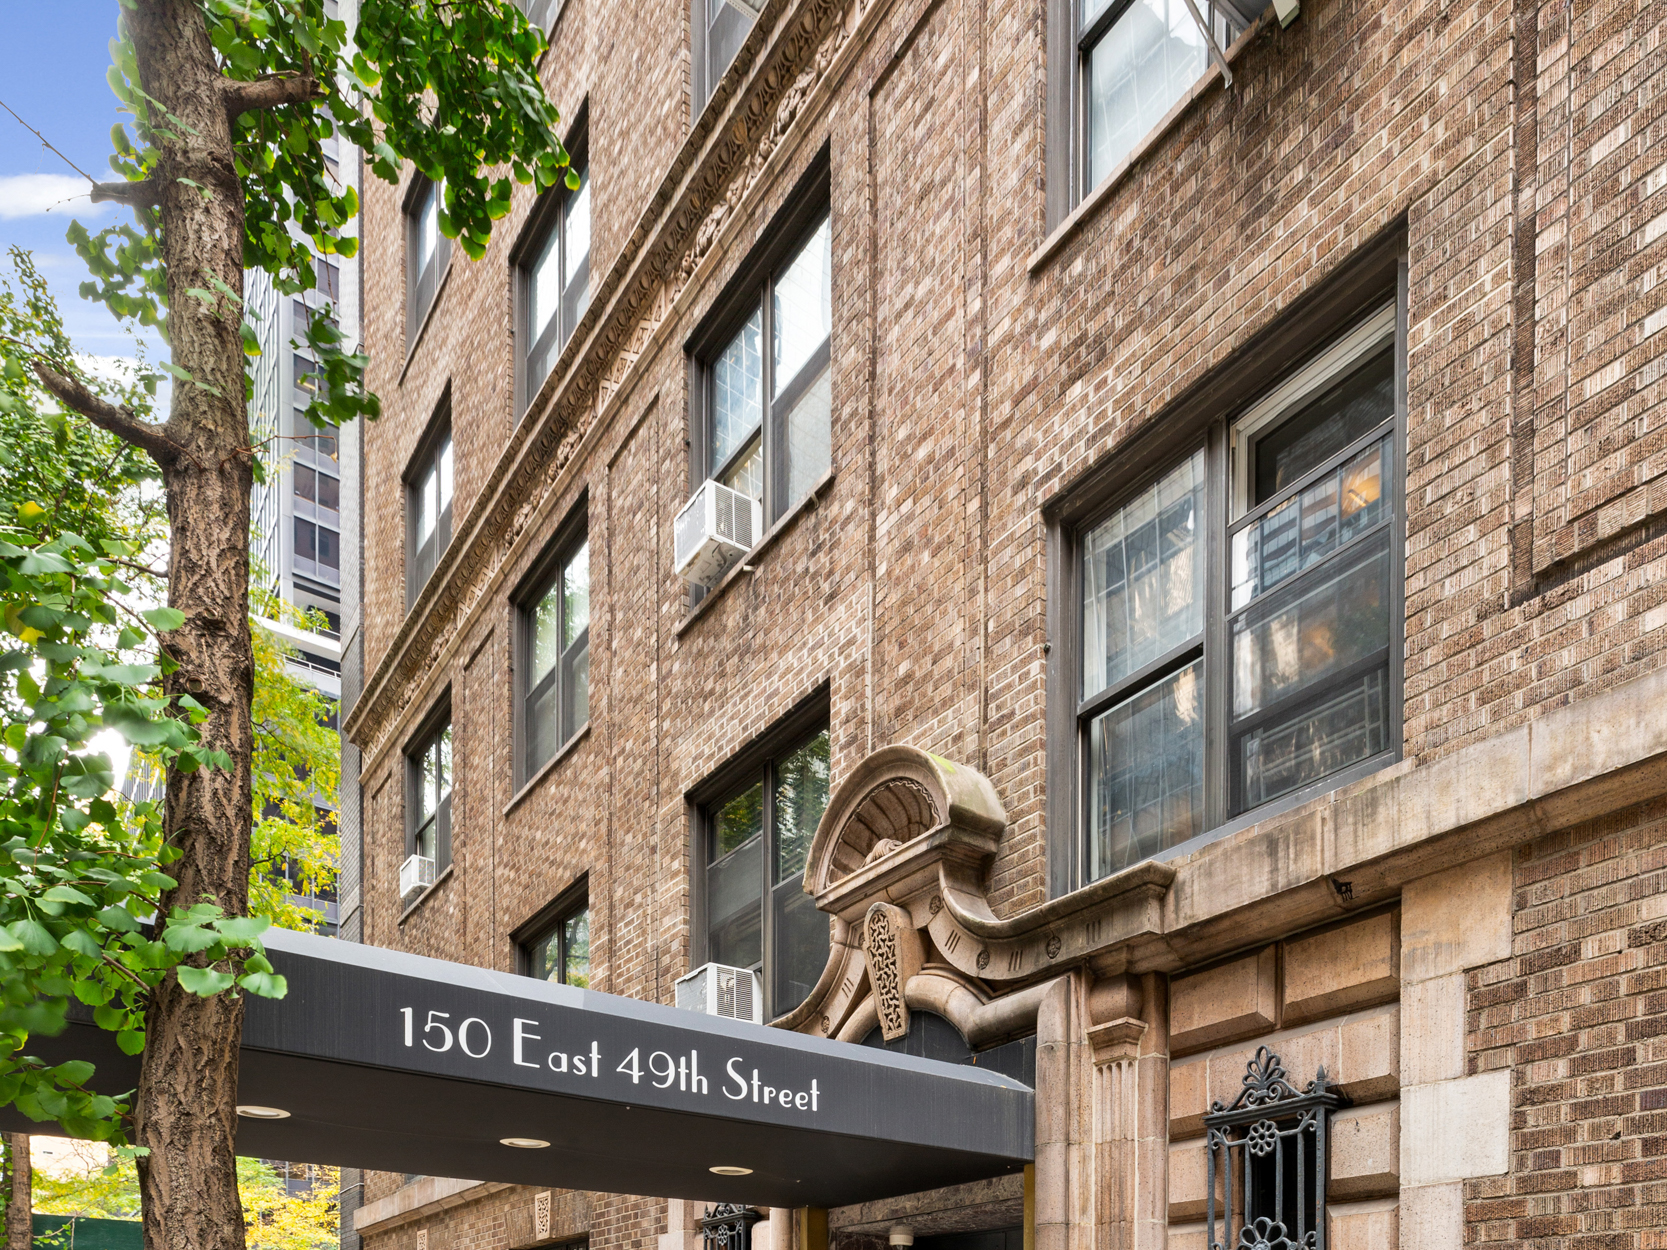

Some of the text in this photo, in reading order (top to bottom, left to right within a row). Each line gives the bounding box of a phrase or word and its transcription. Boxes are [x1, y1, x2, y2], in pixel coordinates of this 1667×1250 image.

[400, 1007, 821, 1112] 150 East 49th Street
